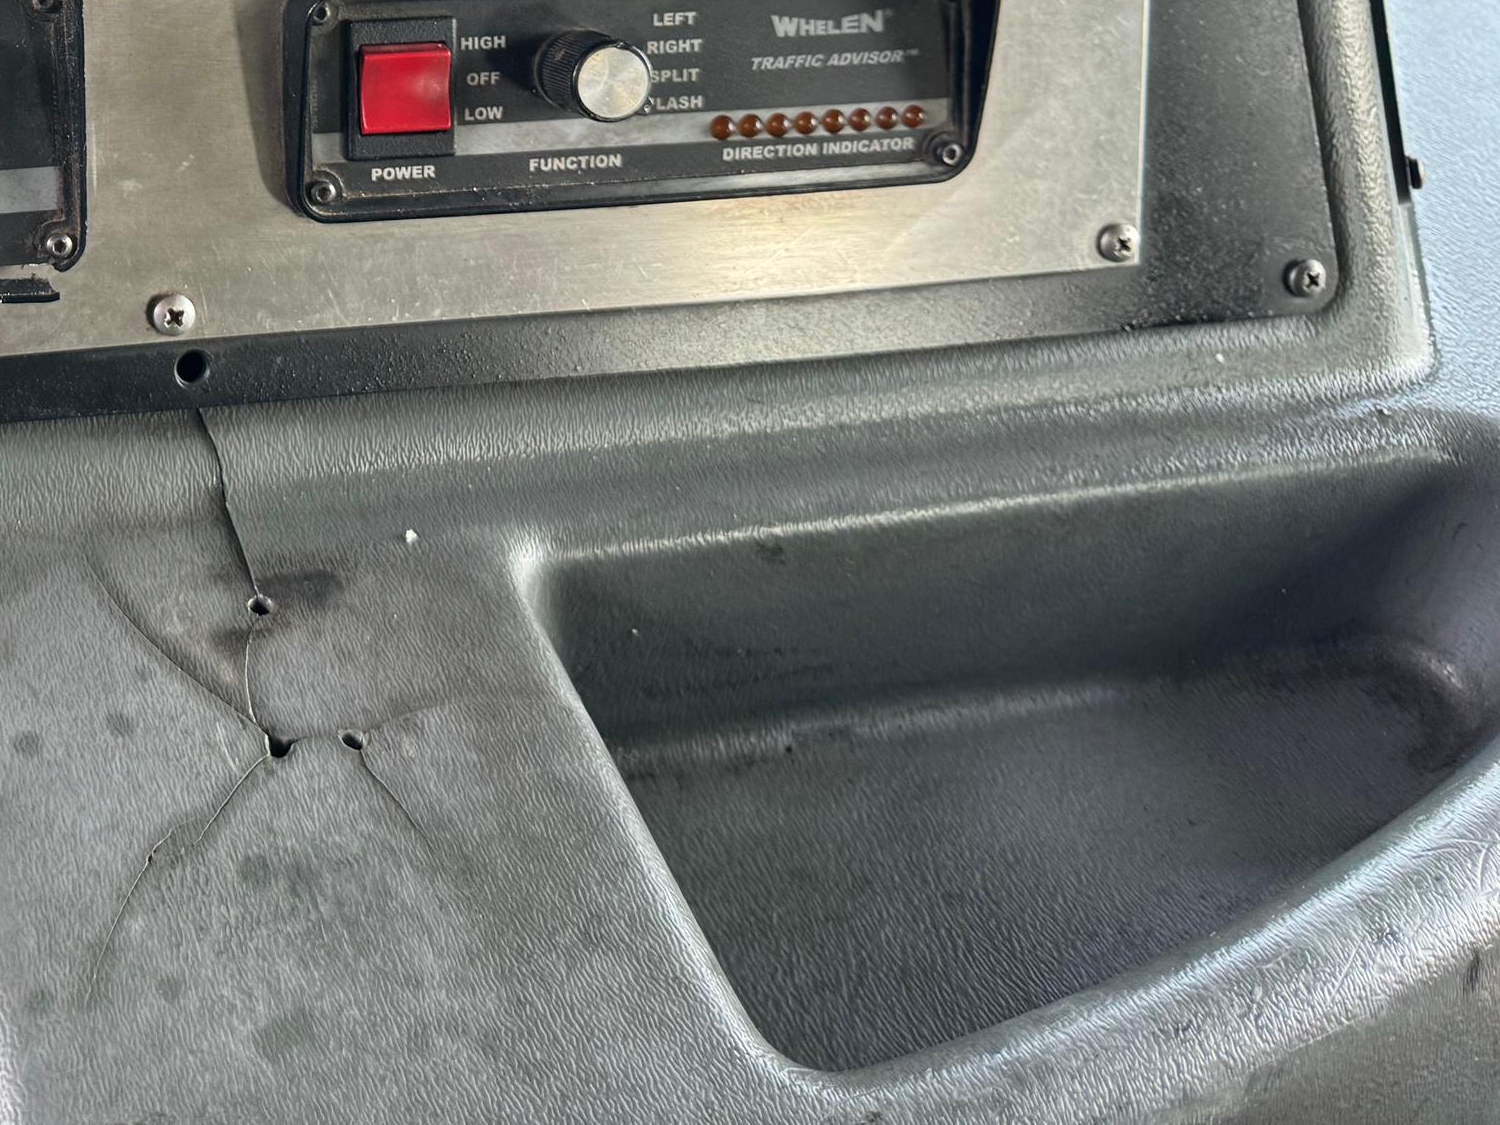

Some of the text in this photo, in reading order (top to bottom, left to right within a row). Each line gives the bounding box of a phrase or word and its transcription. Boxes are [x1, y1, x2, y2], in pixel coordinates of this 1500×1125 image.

[653, 11, 697, 26] LEFT
[460, 35, 506, 50] HIGH
[646, 38, 703, 55] RIGHT
[750, 53, 825, 71] TRAFFIC
[466, 71, 500, 86] OFF
[650, 67, 701, 84] SPLIT
[653, 94, 704, 111] LASH
[464, 106, 504, 121] LOW
[722, 136, 915, 162] DIRECTION INDICATOR
[529, 153, 623, 173] FUNCTION
[371, 165, 436, 182] POWER
